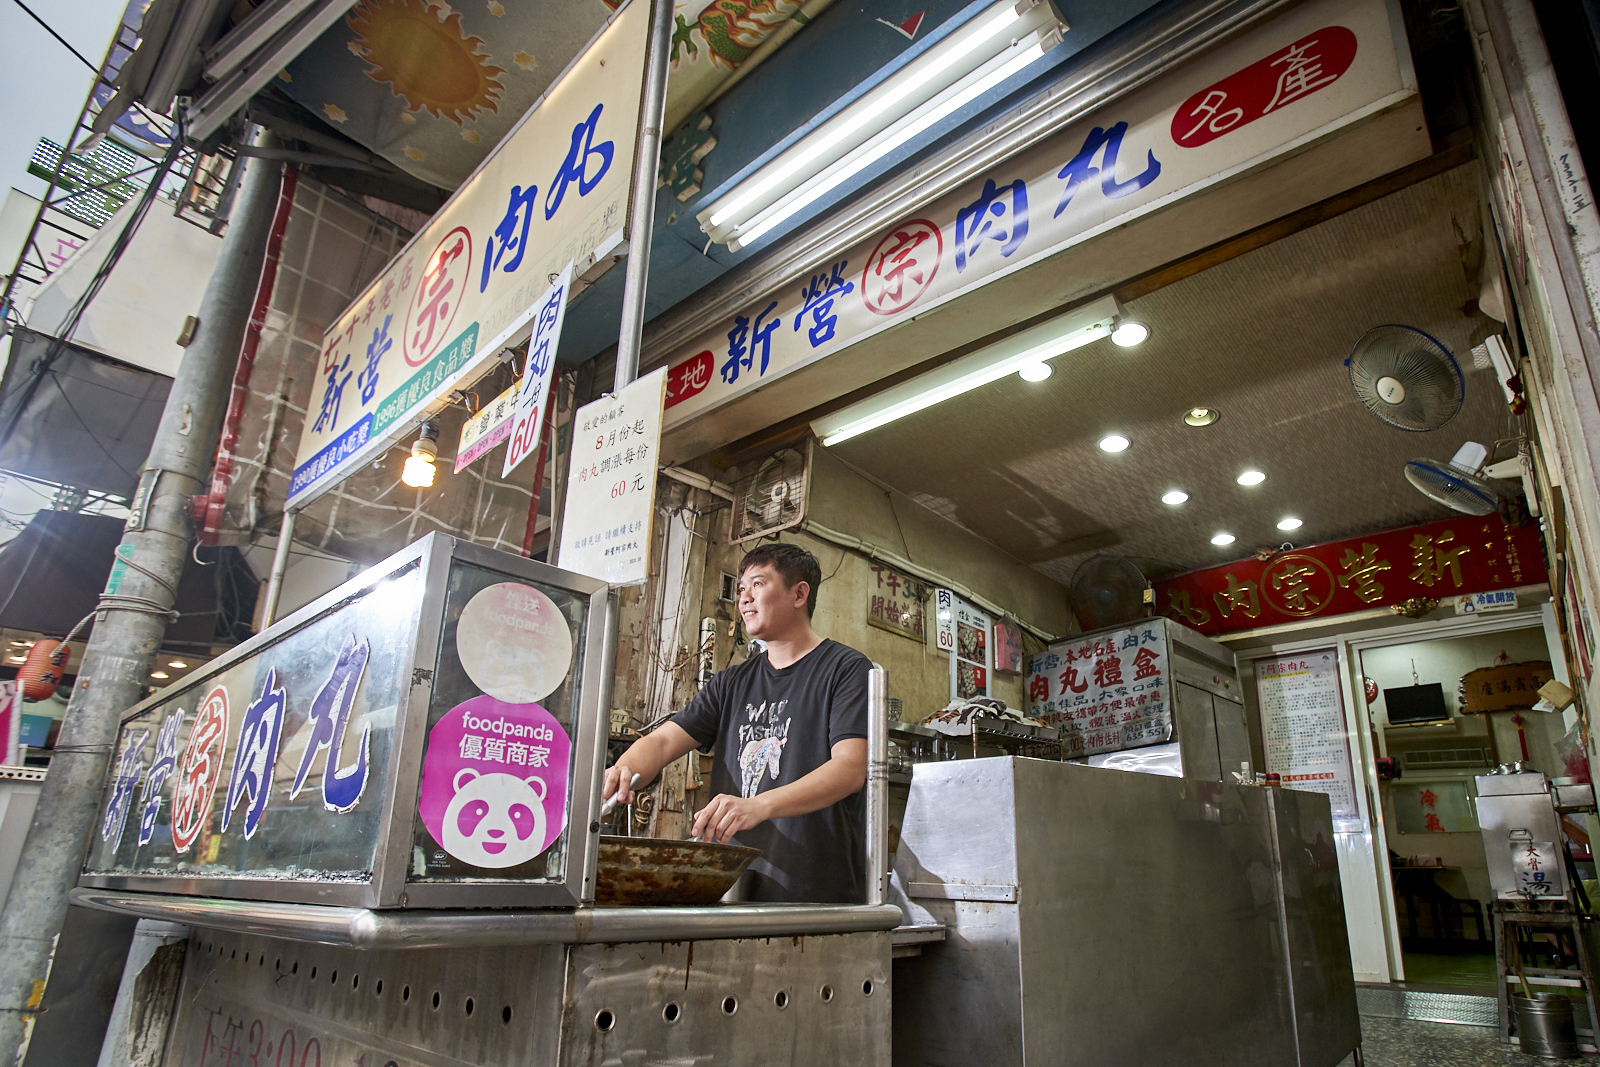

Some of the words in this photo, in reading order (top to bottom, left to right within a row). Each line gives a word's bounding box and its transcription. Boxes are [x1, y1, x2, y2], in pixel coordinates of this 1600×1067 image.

[666, 355, 708, 398] 地
[1181, 38, 1338, 141] 名產
[523, 284, 564, 396] 肉丸
[509, 405, 539, 467] 60
[583, 404, 625, 431] 敬愛的顧客
[578, 442, 649, 483] 肉丸調漲每份
[1476, 591, 1516, 605] 冷氣開放
[484, 607, 555, 637] foodpanda
[940, 630, 953, 648] 60
[1029, 646, 1162, 703] 肉丸禮盒
[1266, 660, 1309, 674] 阿宗肉丸
[461, 711, 554, 741] foodpanda
[458, 733, 551, 769] 優質商家
[1419, 789, 1446, 833] 冷氣
[1522, 845, 1553, 894] 大骨湯
